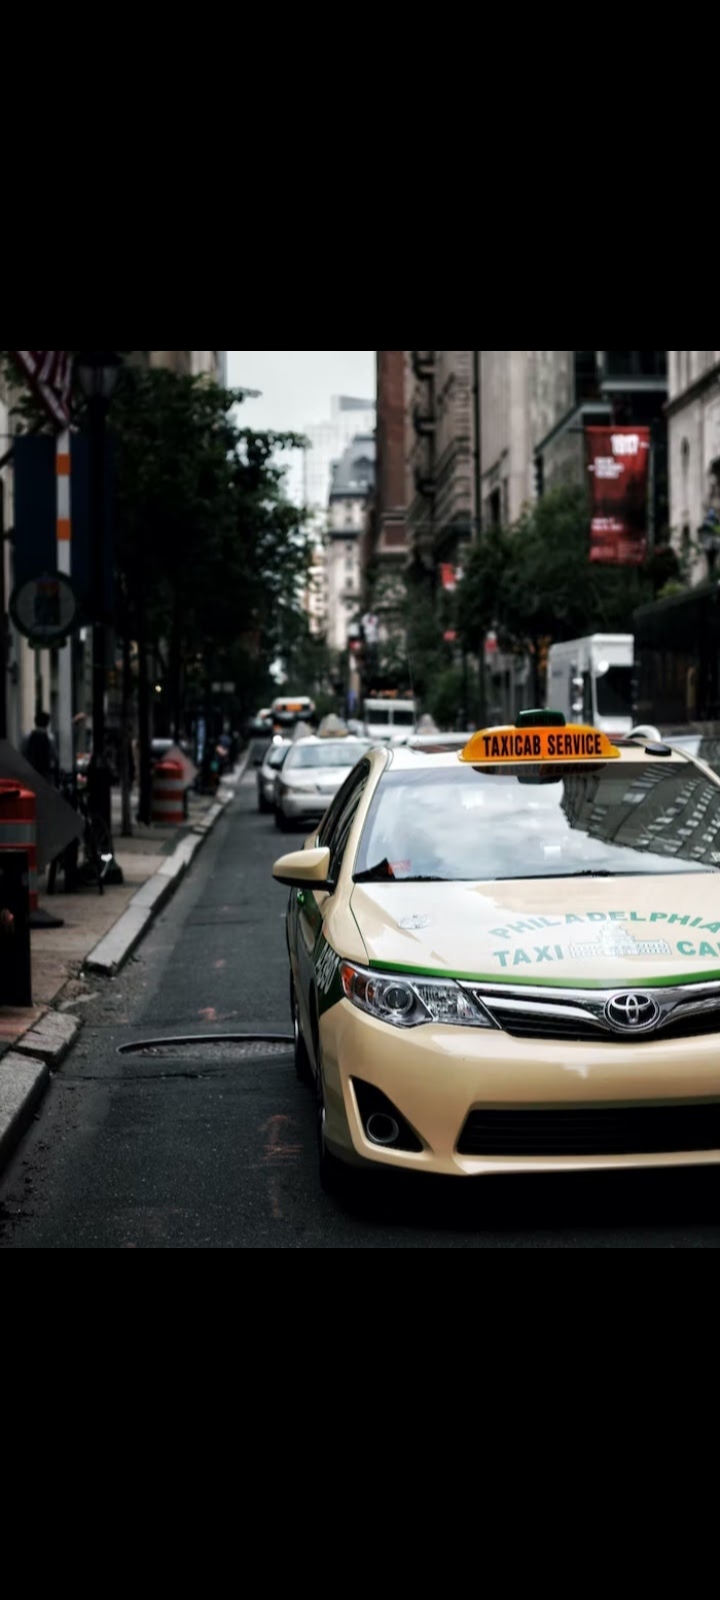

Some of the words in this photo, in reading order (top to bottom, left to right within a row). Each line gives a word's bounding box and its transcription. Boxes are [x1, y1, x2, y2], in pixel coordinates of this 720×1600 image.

[482, 734, 541, 757] TAXICAB
[547, 733, 602, 755] SERVICE
[488, 911, 720, 939] PHILADELPHIA
[493, 944, 564, 967] TAXI
[676, 940, 720, 958] CA
